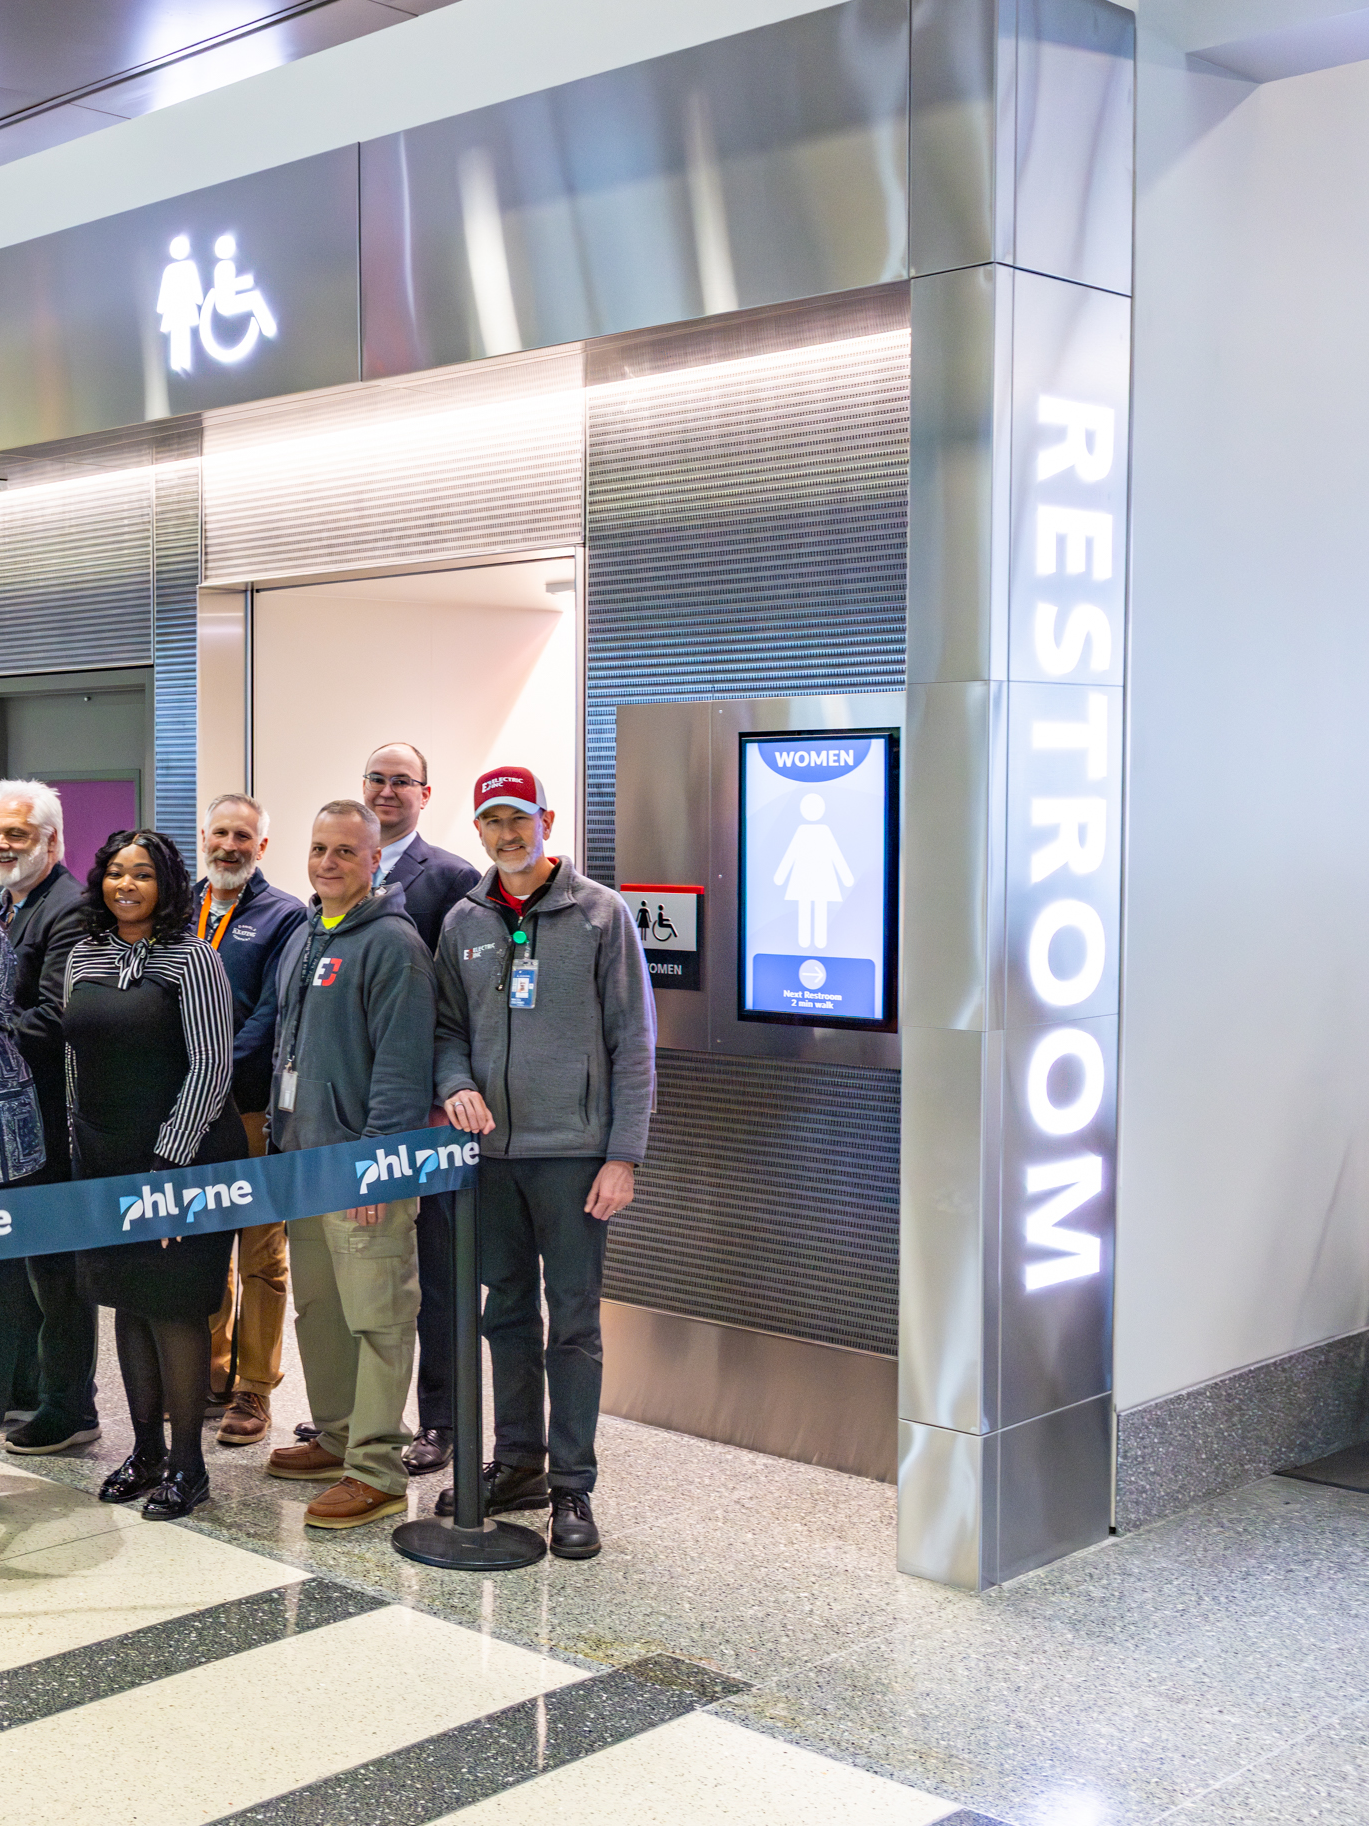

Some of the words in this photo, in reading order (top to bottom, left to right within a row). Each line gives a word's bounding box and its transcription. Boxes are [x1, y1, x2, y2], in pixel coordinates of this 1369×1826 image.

[774, 749, 854, 768] WOMEN
[1025, 393, 1115, 1293] RESTROOM
[647, 962, 683, 975] OMEN
[783, 989, 803, 998] Next
[804, 991, 843, 1001] Restroom
[791, 999, 798, 1007] 2
[798, 1000, 813, 1008] min
[814, 1001, 834, 1009] walk
